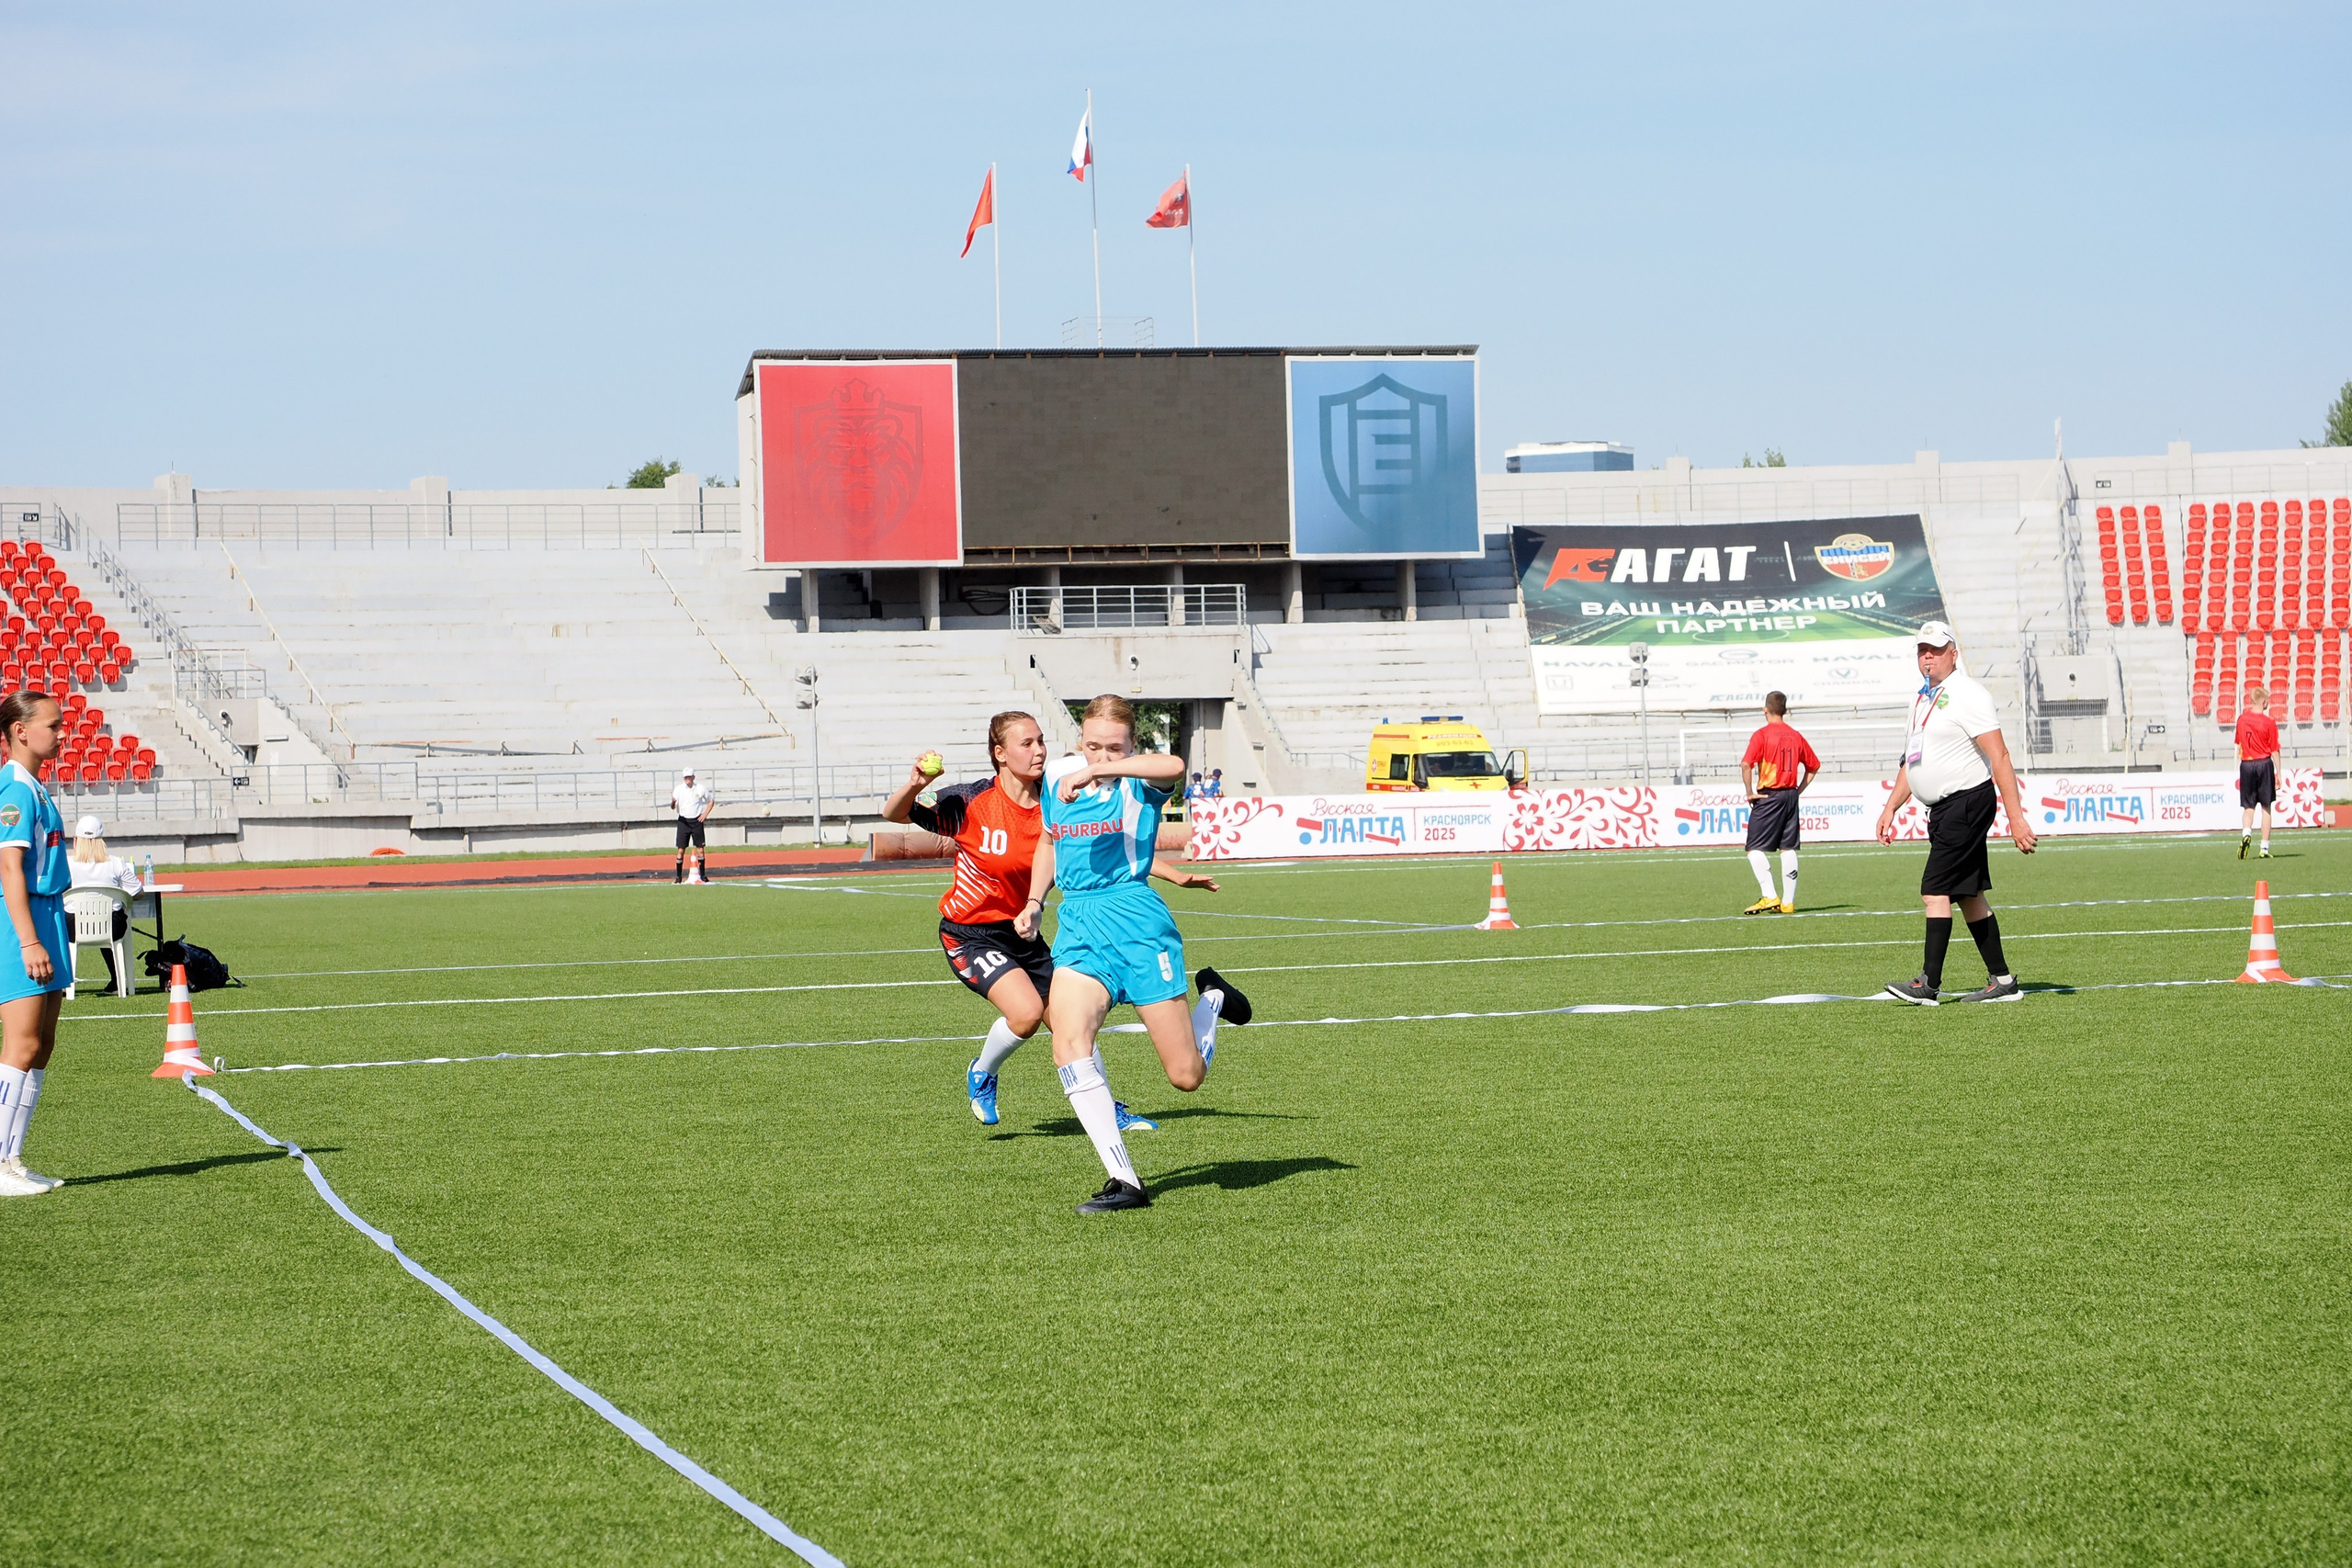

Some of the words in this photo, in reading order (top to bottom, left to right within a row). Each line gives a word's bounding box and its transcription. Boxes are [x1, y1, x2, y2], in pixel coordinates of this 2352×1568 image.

[1610, 546, 1757, 583] АГАТ
[1580, 601, 1661, 616] ВАШ
[1670, 591, 1886, 617] НАДЕЖНЫЙ
[1656, 615, 1817, 634] ПАРТНЕР
[1813, 653, 1902, 662] HAVAL
[2245, 731, 2253, 749] 7
[1781, 747, 1793, 773] 11
[2053, 778, 2117, 795] Русская
[1310, 797, 1377, 816] Русская
[2064, 795, 2145, 823] ЛАПТА
[2160, 793, 2225, 806] КРАСНОЯРСК
[1799, 804, 1864, 816] КРАСНОЯРСК
[2161, 807, 2191, 819] 2025
[1060, 818, 1124, 839] FURBAU
[1423, 814, 1492, 826] КРАСНОЯРСК
[1800, 818, 1829, 830] 2025
[1319, 816, 1407, 844] ЛАПТА
[1424, 828, 1456, 841] 2025
[978, 825, 1008, 856] 10
[1158, 951, 1173, 982] 5
